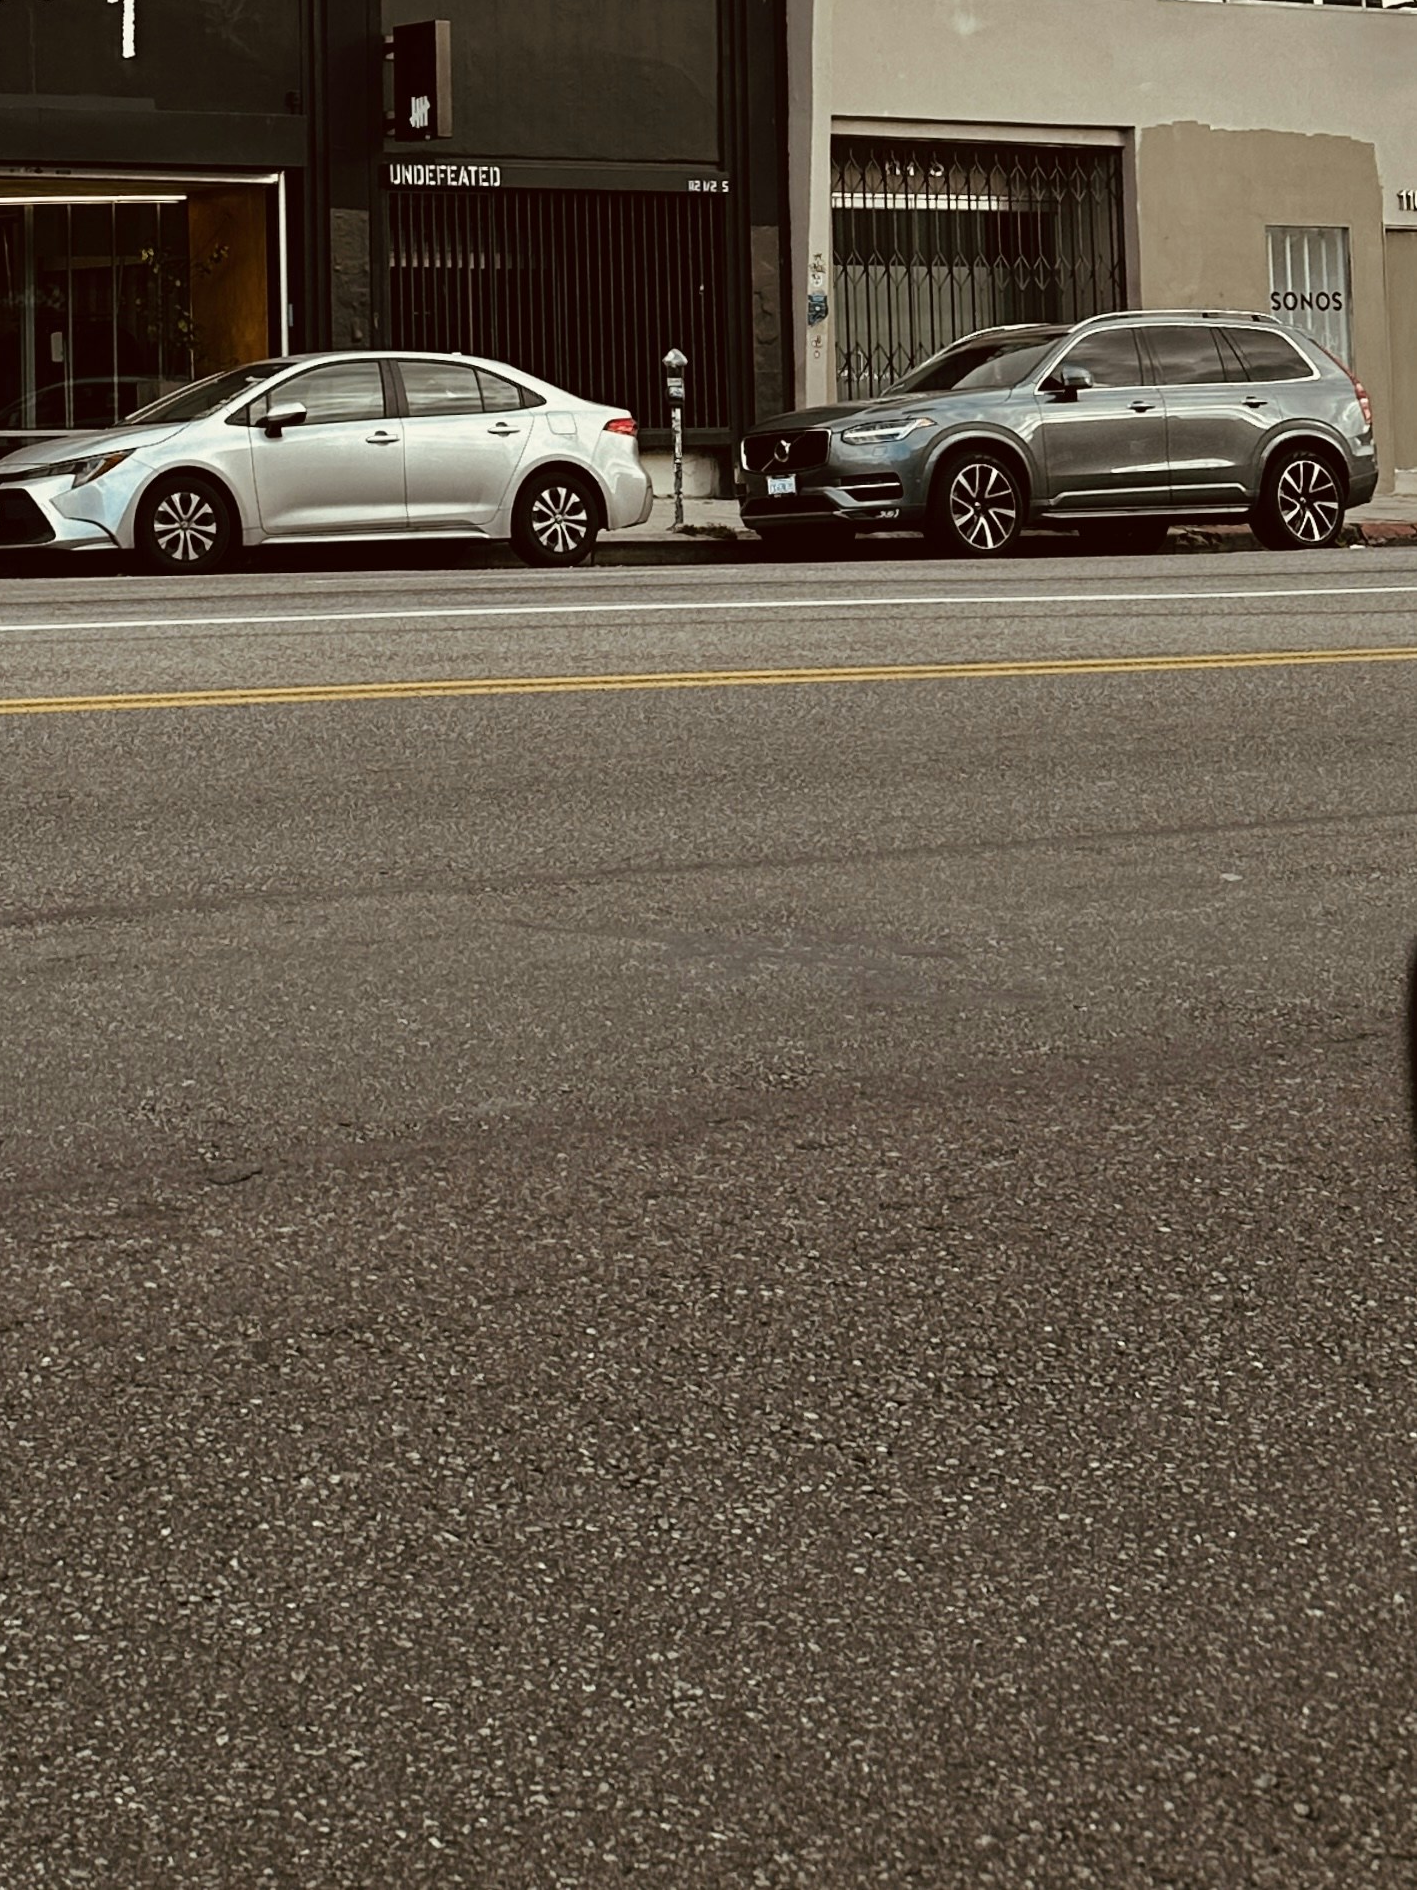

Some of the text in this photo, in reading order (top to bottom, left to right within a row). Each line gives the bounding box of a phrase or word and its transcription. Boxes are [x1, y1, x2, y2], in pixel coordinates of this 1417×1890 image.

[390, 164, 501, 187] UNDEFEATED
[721, 180, 730, 193] S
[1270, 291, 1343, 311] SONOS
